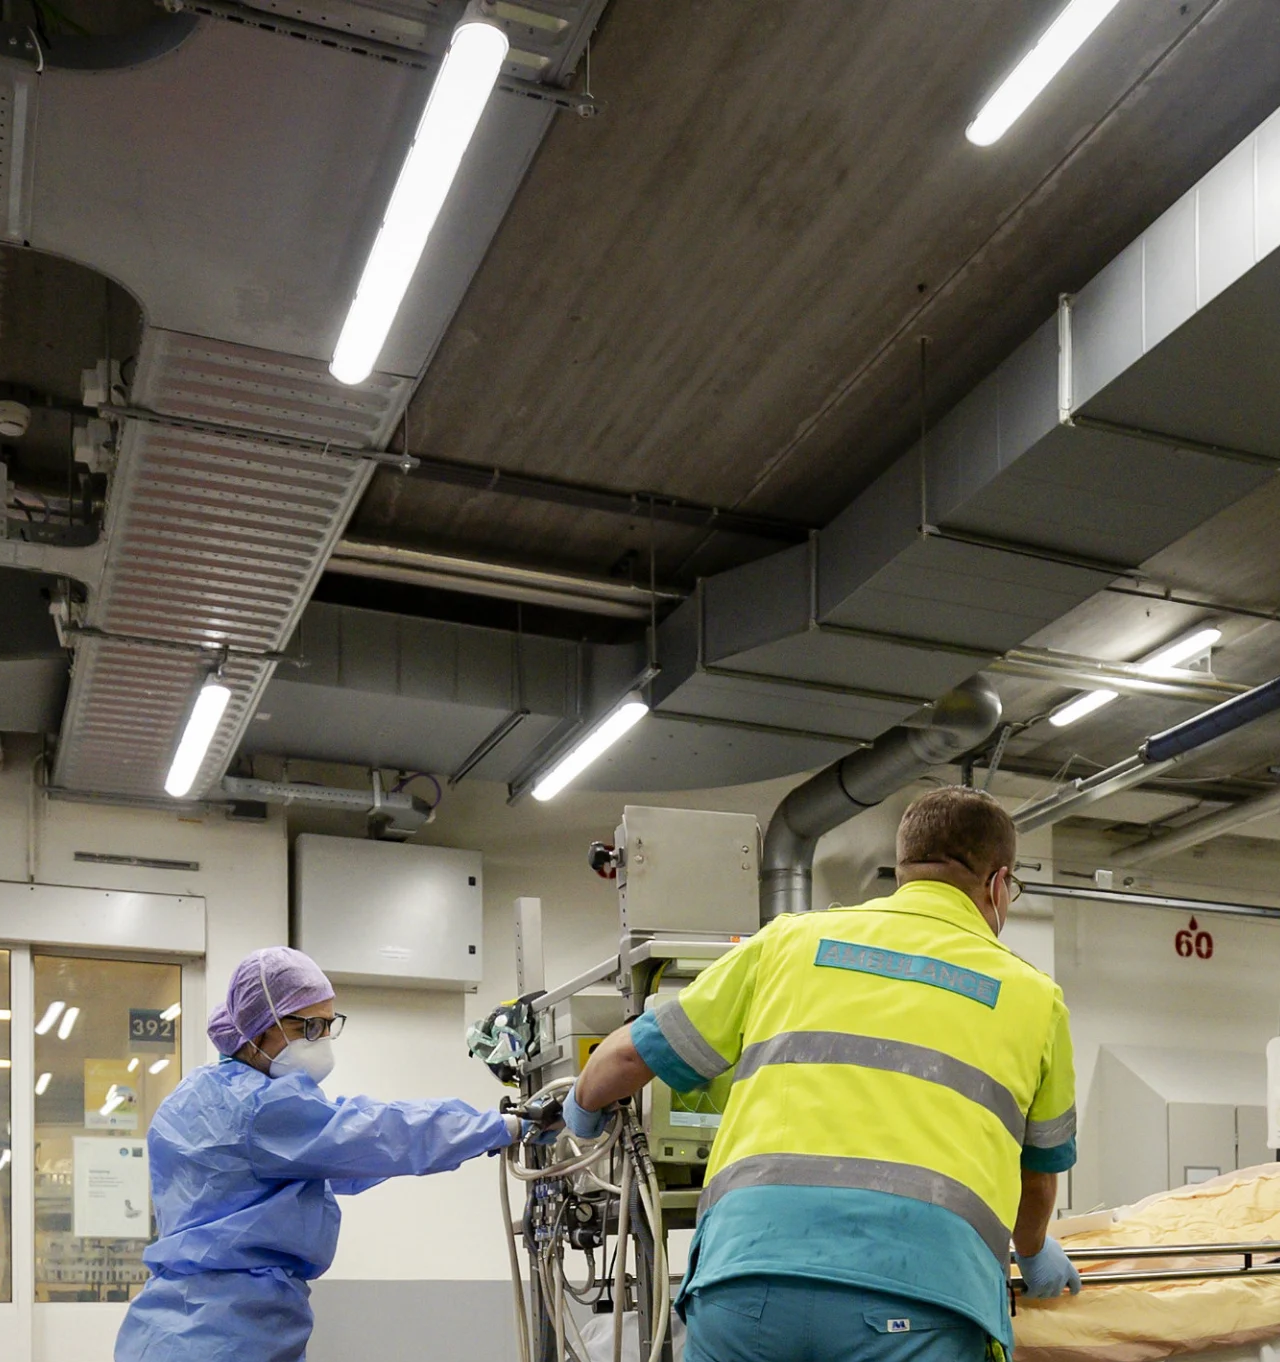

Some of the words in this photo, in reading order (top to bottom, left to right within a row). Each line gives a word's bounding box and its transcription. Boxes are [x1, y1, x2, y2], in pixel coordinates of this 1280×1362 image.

[1175, 930, 1213, 959] 60
[822, 943, 995, 1001] AMBULANCE
[132, 1019, 172, 1036] 392
